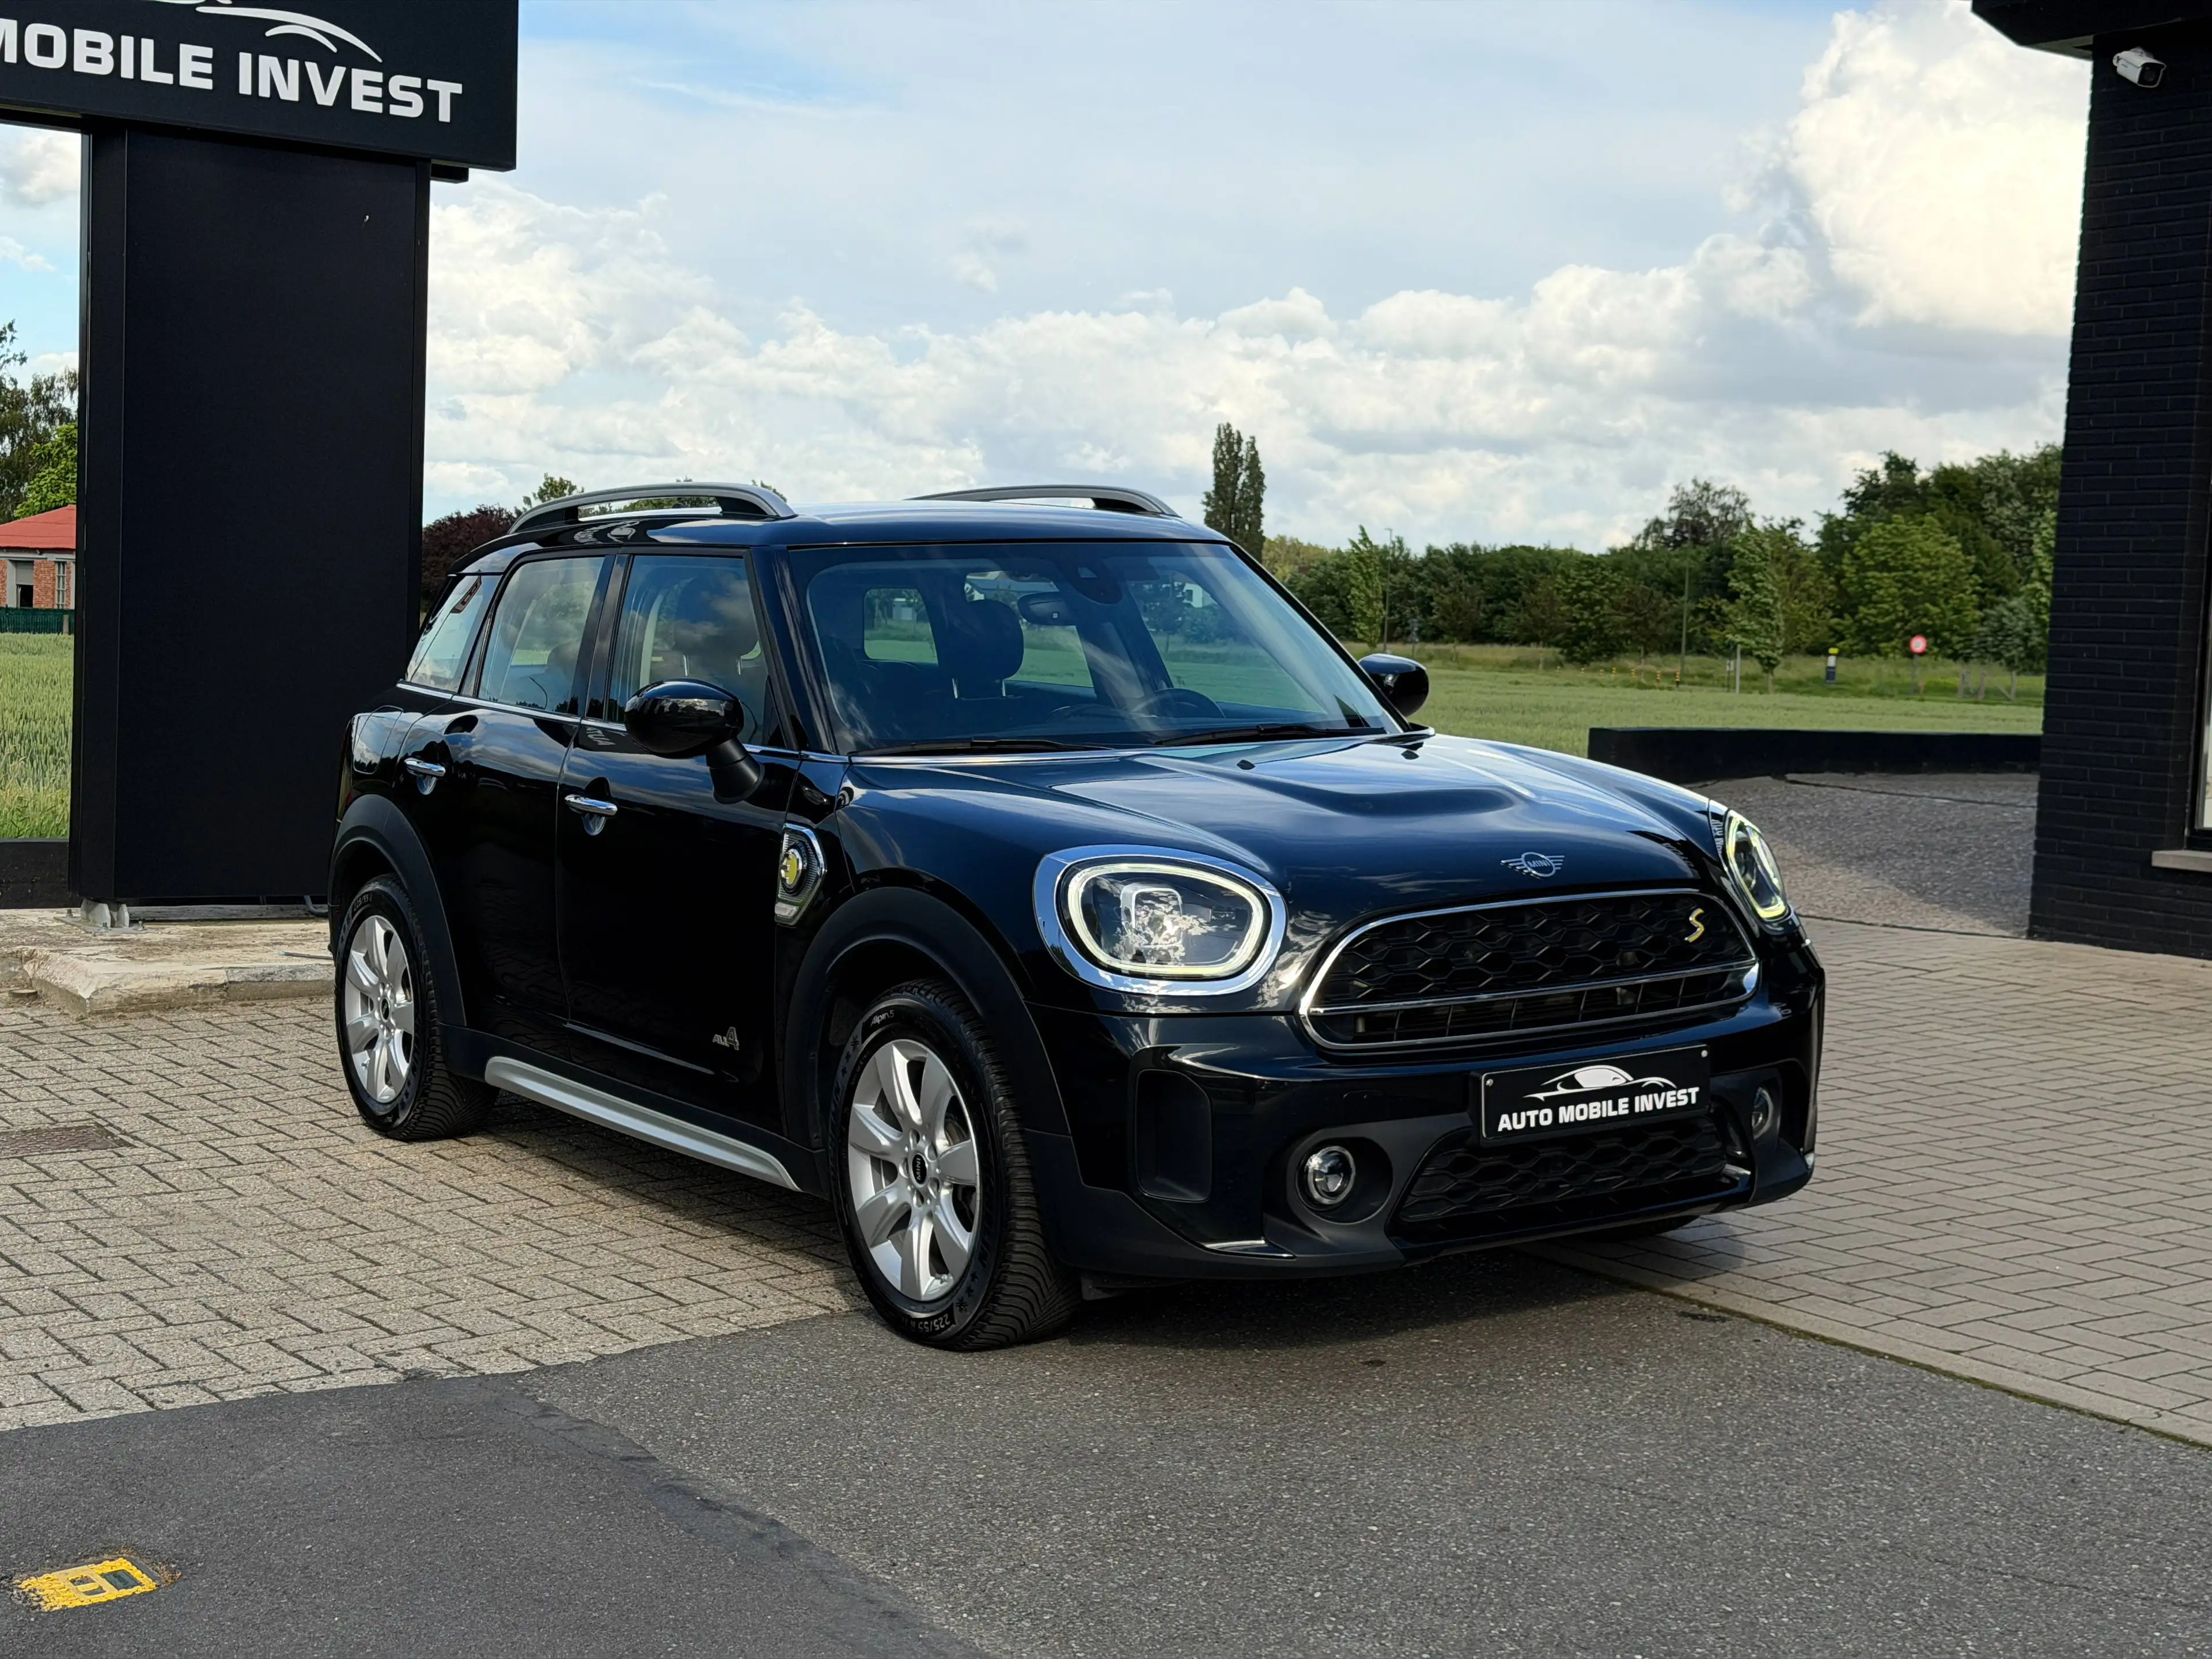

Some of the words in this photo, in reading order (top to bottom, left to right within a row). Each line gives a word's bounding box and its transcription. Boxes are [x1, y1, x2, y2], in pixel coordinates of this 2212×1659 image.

[238, 52, 463, 123] INVEST
[1527, 859, 1551, 868] MINI
[1685, 907, 1705, 943] S
[1497, 1108, 1553, 1132] AUTO
[1559, 1097, 1629, 1123] MOBILE
[1634, 1086, 1700, 1113] INVEST
